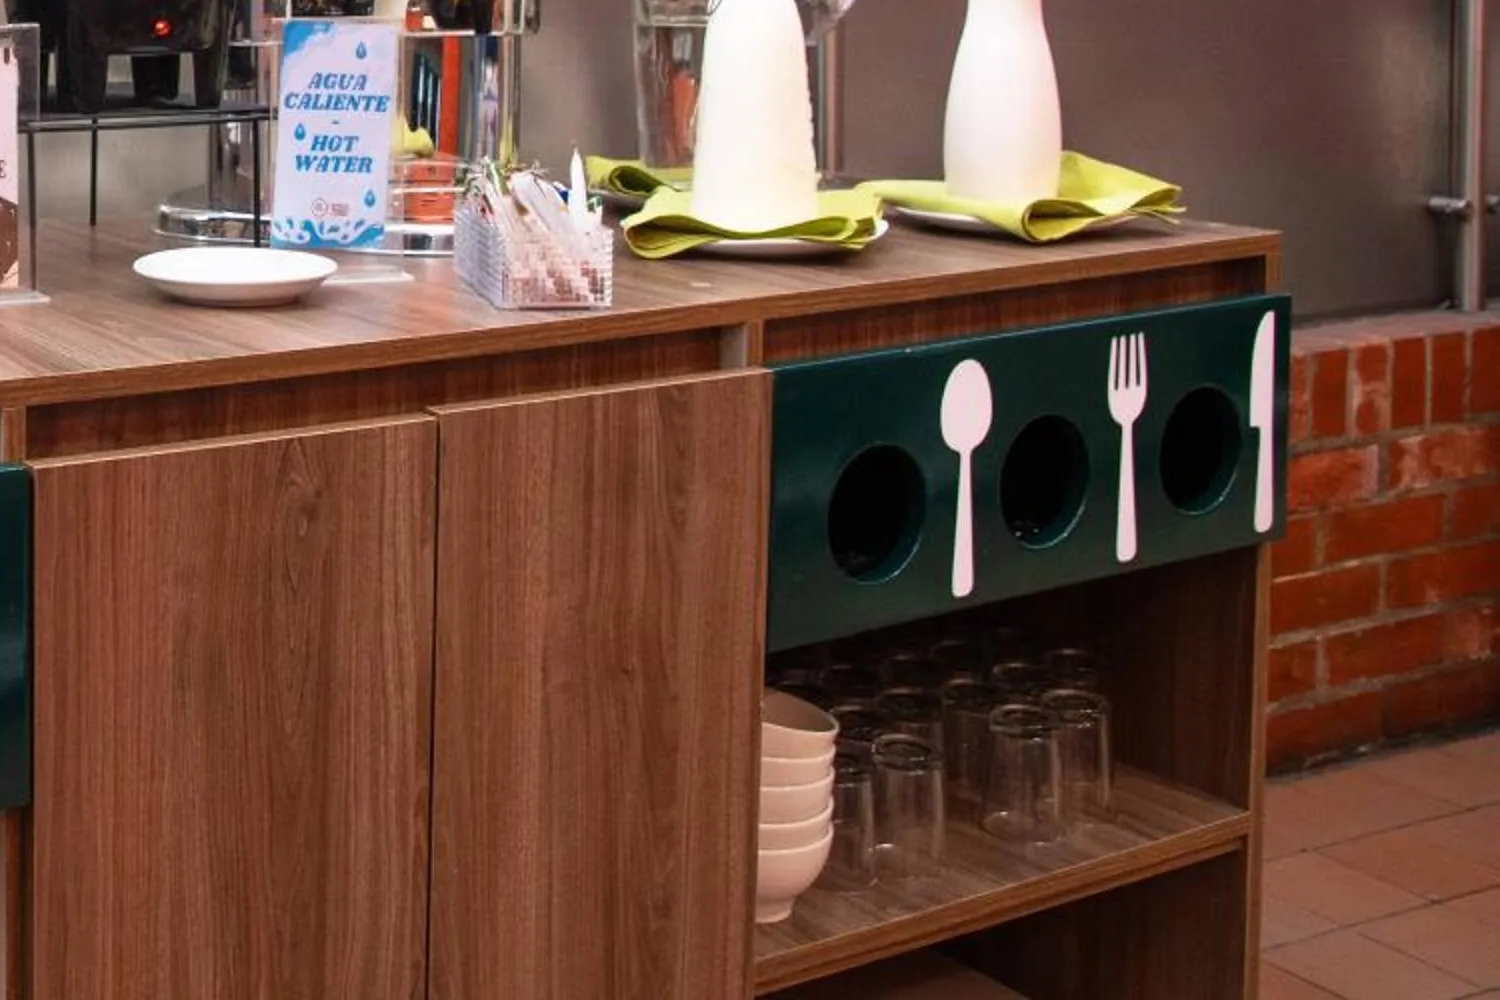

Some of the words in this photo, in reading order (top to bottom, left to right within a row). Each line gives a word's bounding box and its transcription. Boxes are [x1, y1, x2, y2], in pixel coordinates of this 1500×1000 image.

[307, 72, 367, 91] AGUA
[284, 92, 391, 113] CALIENTE
[310, 135, 360, 153] HOT
[295, 154, 373, 173] WATER
